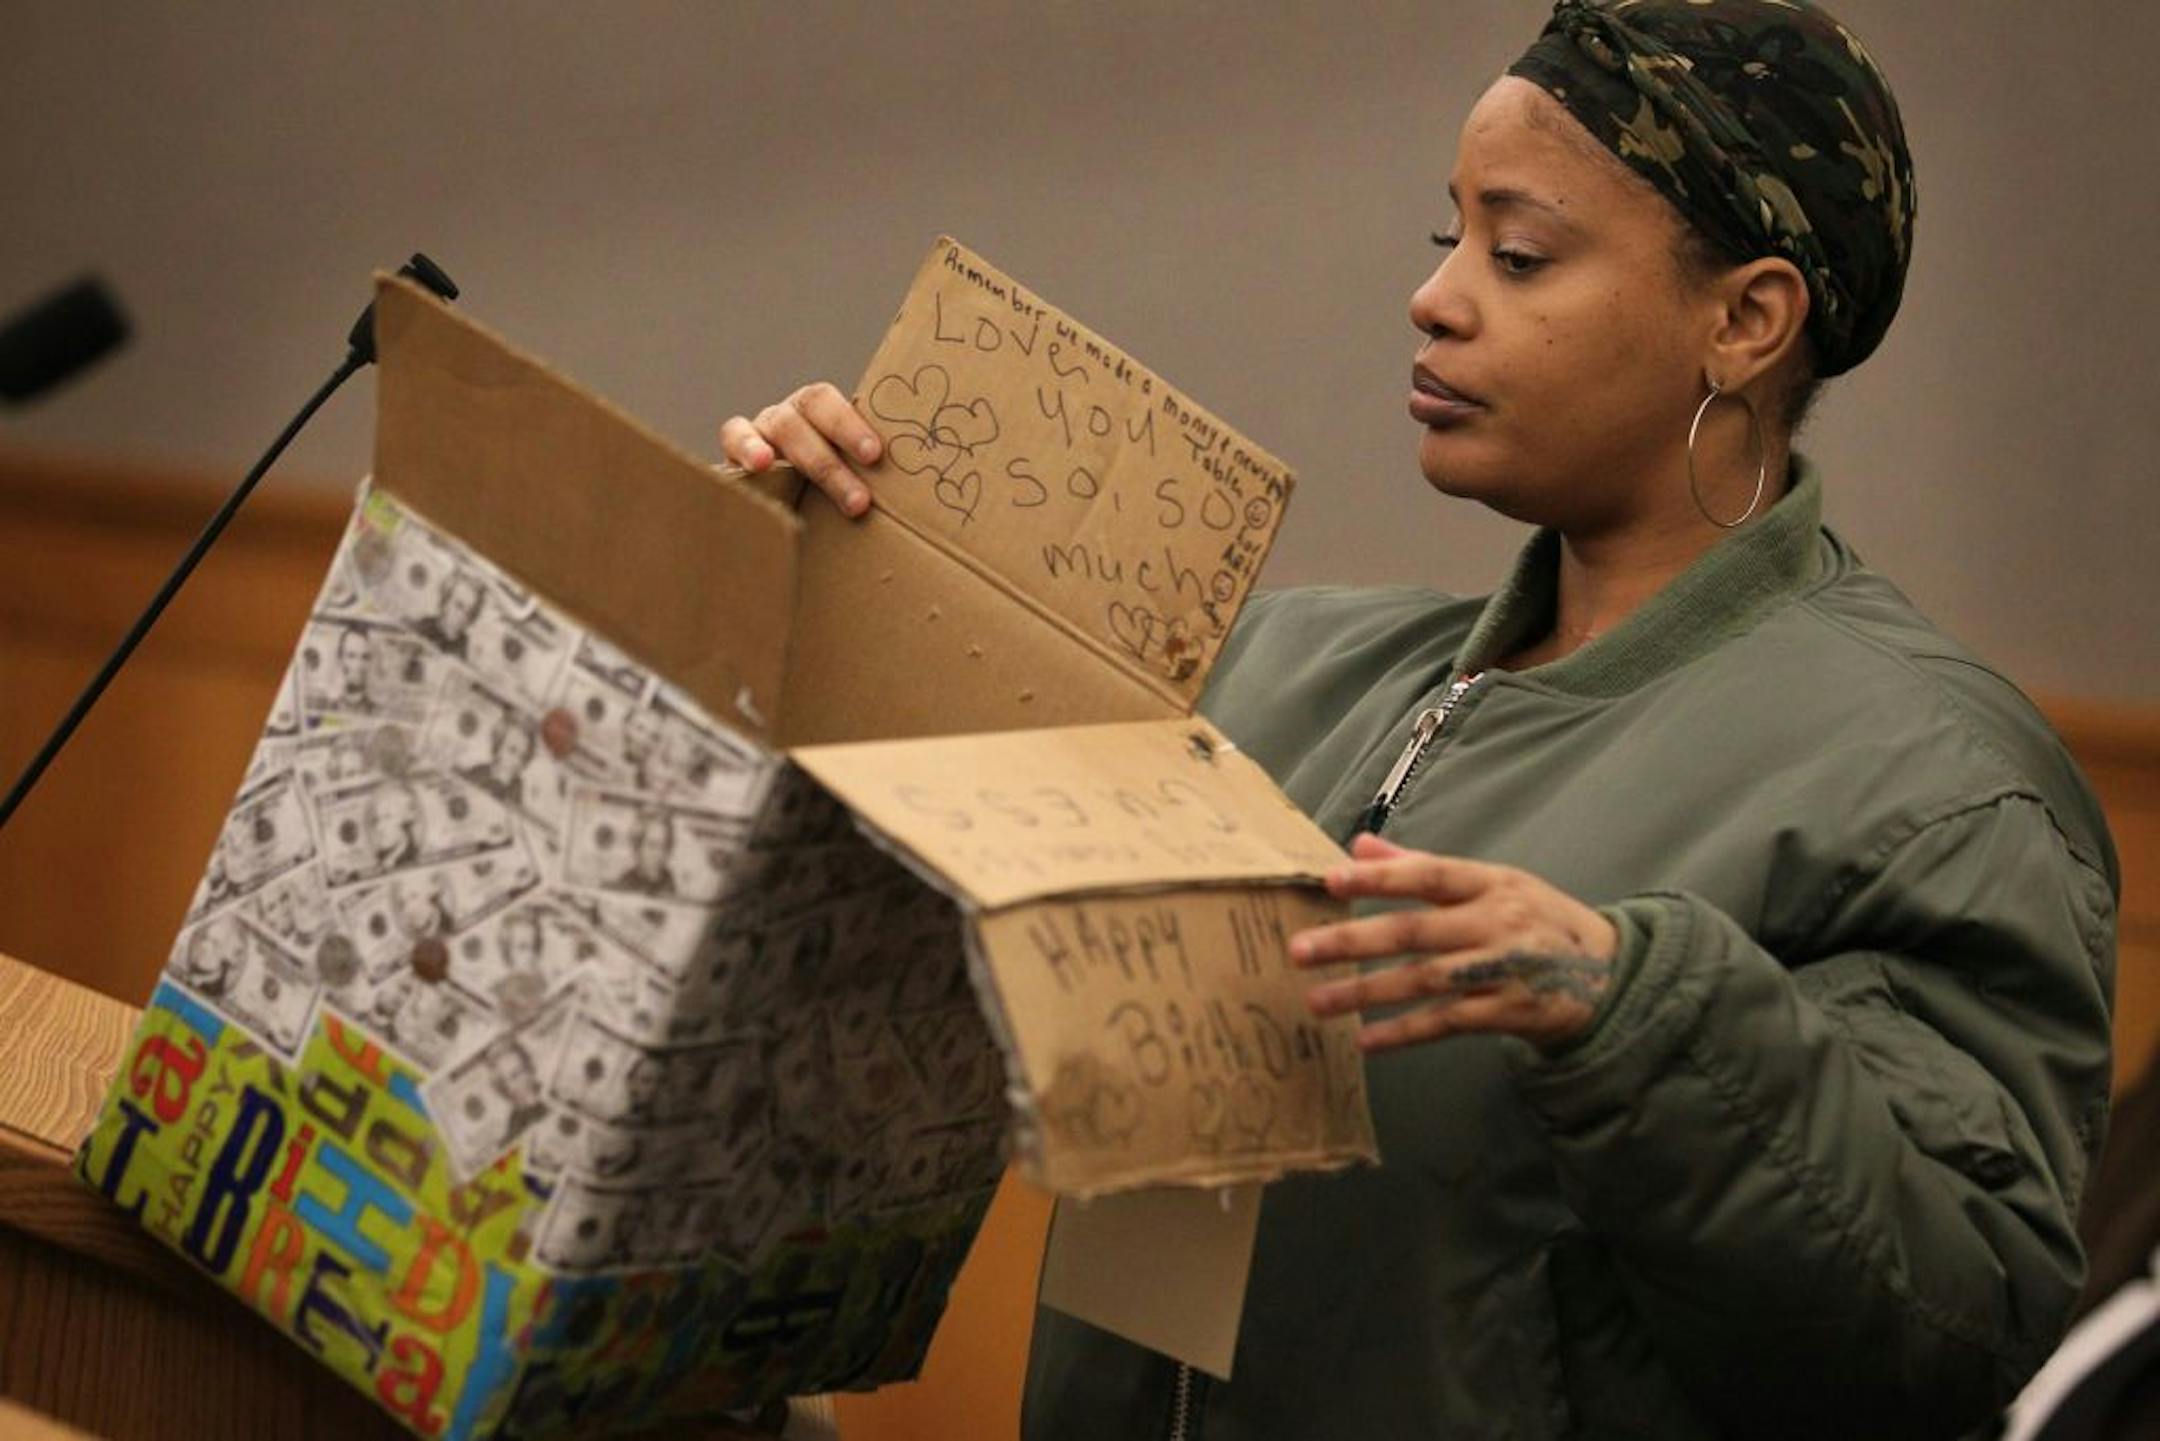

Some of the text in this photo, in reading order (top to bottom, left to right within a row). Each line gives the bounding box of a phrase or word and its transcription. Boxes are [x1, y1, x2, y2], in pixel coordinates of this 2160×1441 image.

[942, 246, 1046, 321] Remember
[1056, 320, 1079, 348] we
[1085, 343, 1134, 386] made
[1142, 377, 1153, 395] a
[1163, 395, 1219, 450] money
[1043, 542, 1205, 601] much
[150, 1069, 235, 1238] HAPPY
